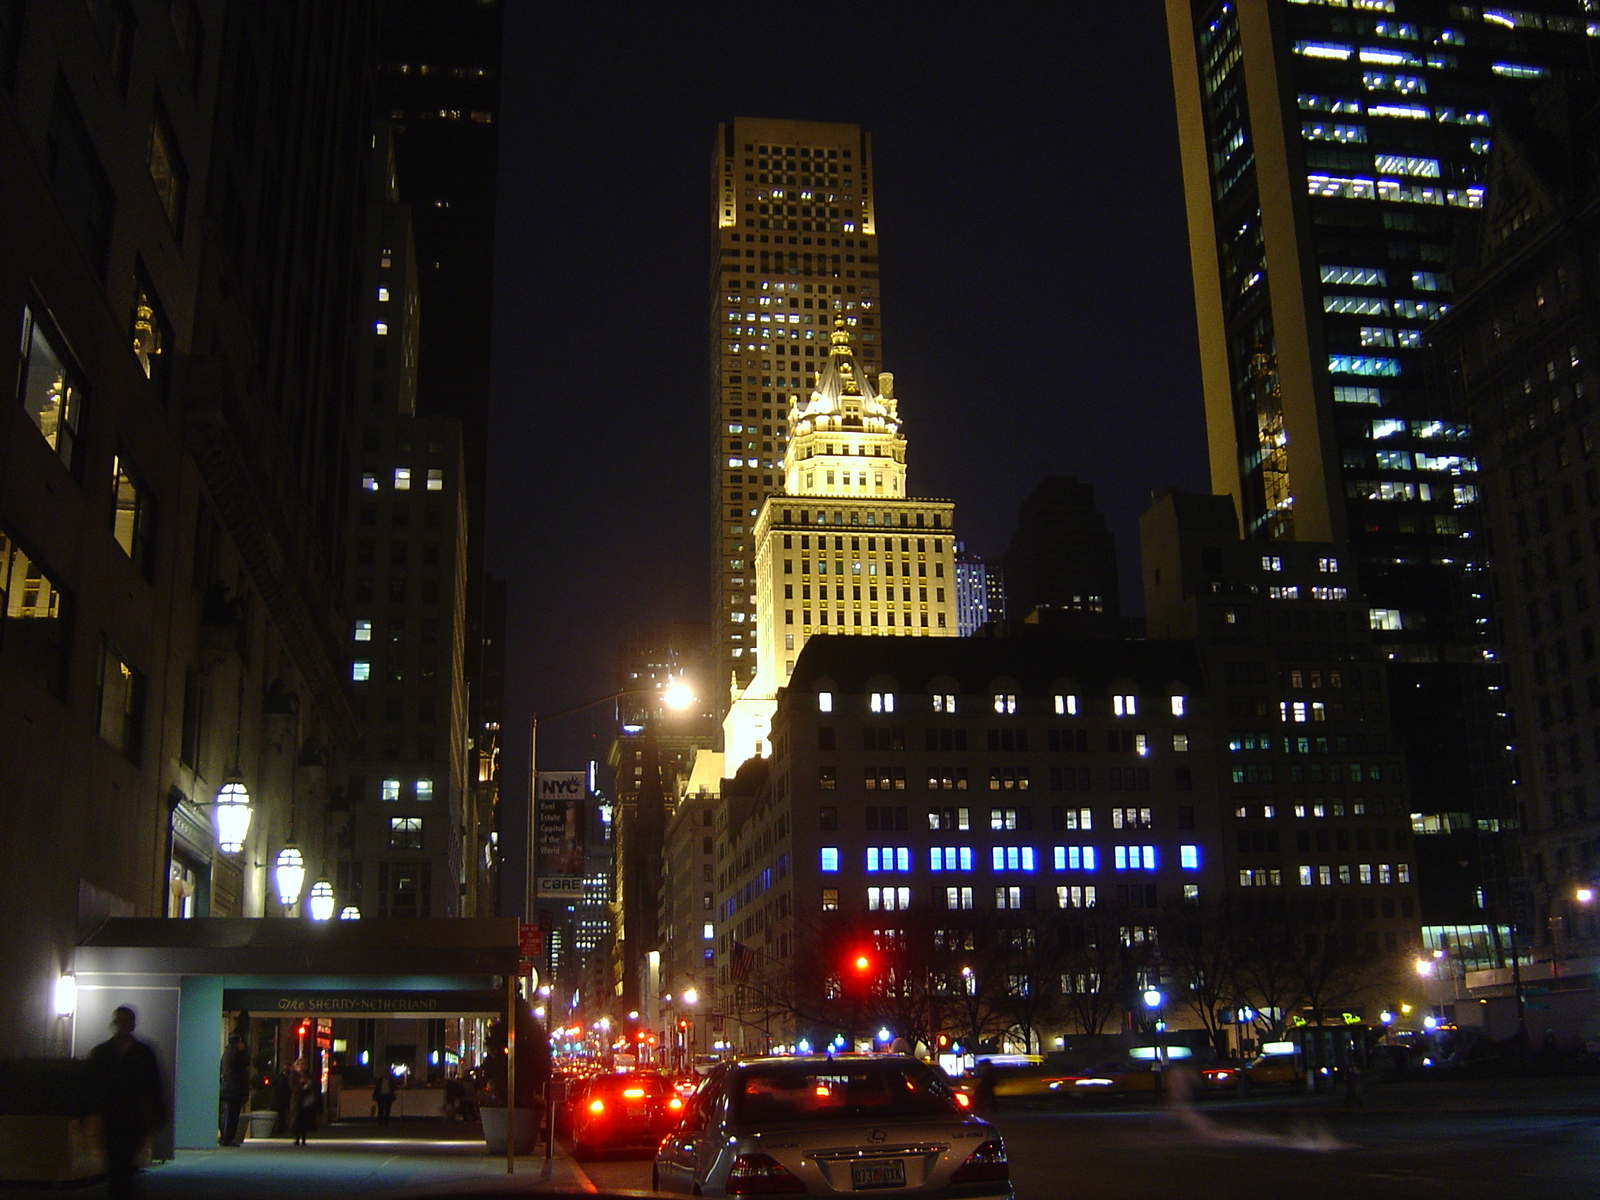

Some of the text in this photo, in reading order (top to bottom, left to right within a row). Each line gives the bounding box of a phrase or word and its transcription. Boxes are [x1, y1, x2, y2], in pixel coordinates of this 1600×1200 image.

[542, 778, 580, 794] NYC
[541, 802, 555, 810] Real
[541, 813, 560, 821] Estate
[541, 824, 564, 833] Capital
[548, 835, 560, 843] the
[541, 846, 560, 854] World
[542, 879, 580, 890] CBRE
[277, 998, 437, 1010] The SHERRY-NETHERLAND
